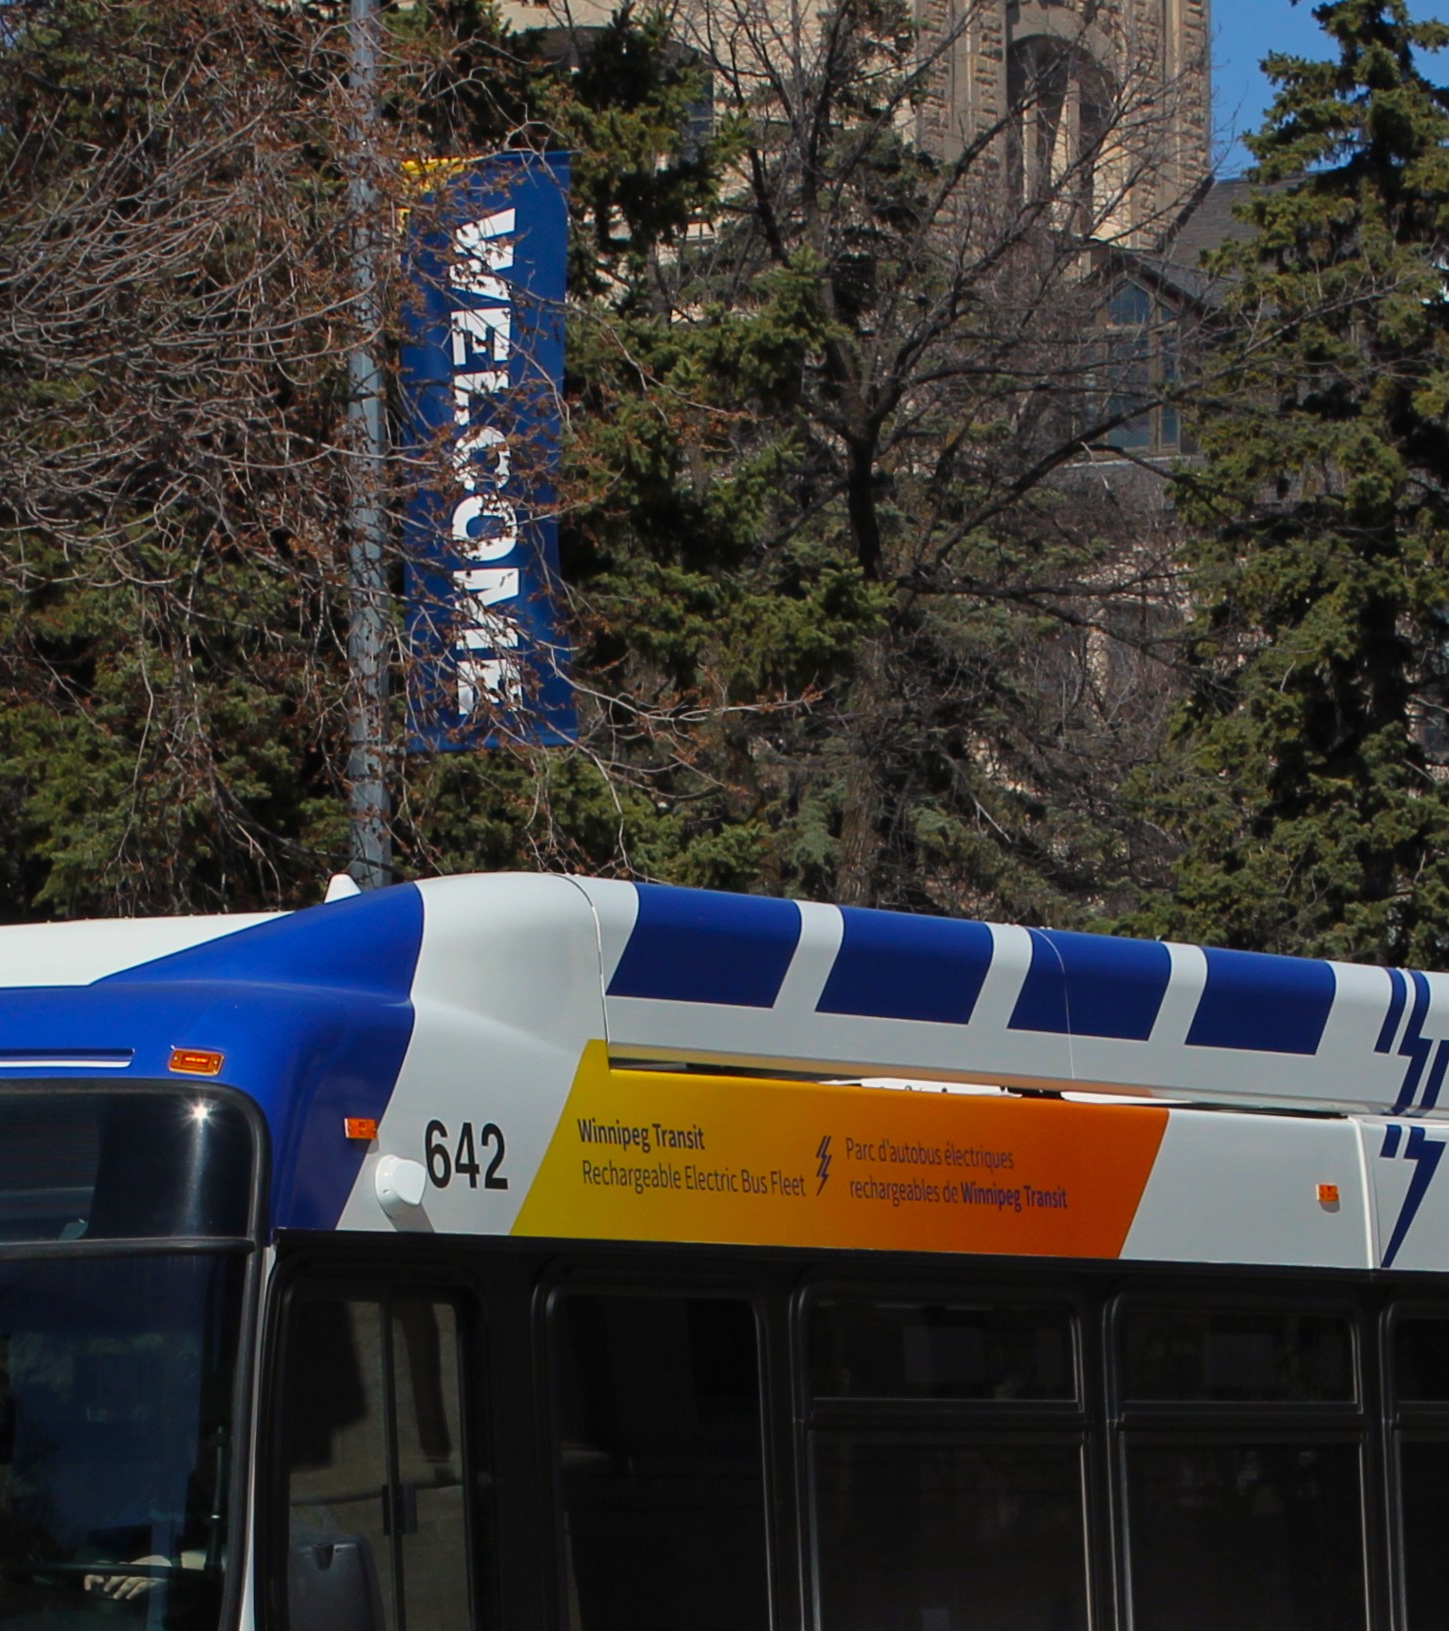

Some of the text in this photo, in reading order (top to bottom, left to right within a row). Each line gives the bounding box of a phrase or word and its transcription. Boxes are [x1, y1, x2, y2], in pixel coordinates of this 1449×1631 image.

[449, 207, 524, 715] WELCOME
[425, 1119, 508, 1190] 642
[577, 1118, 706, 1153] Winnipeg Transit
[845, 1137, 1014, 1174] Parc d'autobus électriques
[582, 1159, 806, 1197] Rechargeable Electric Bus Fleet
[849, 1175, 1068, 1213] rechargeables de Winnipeg Transit
